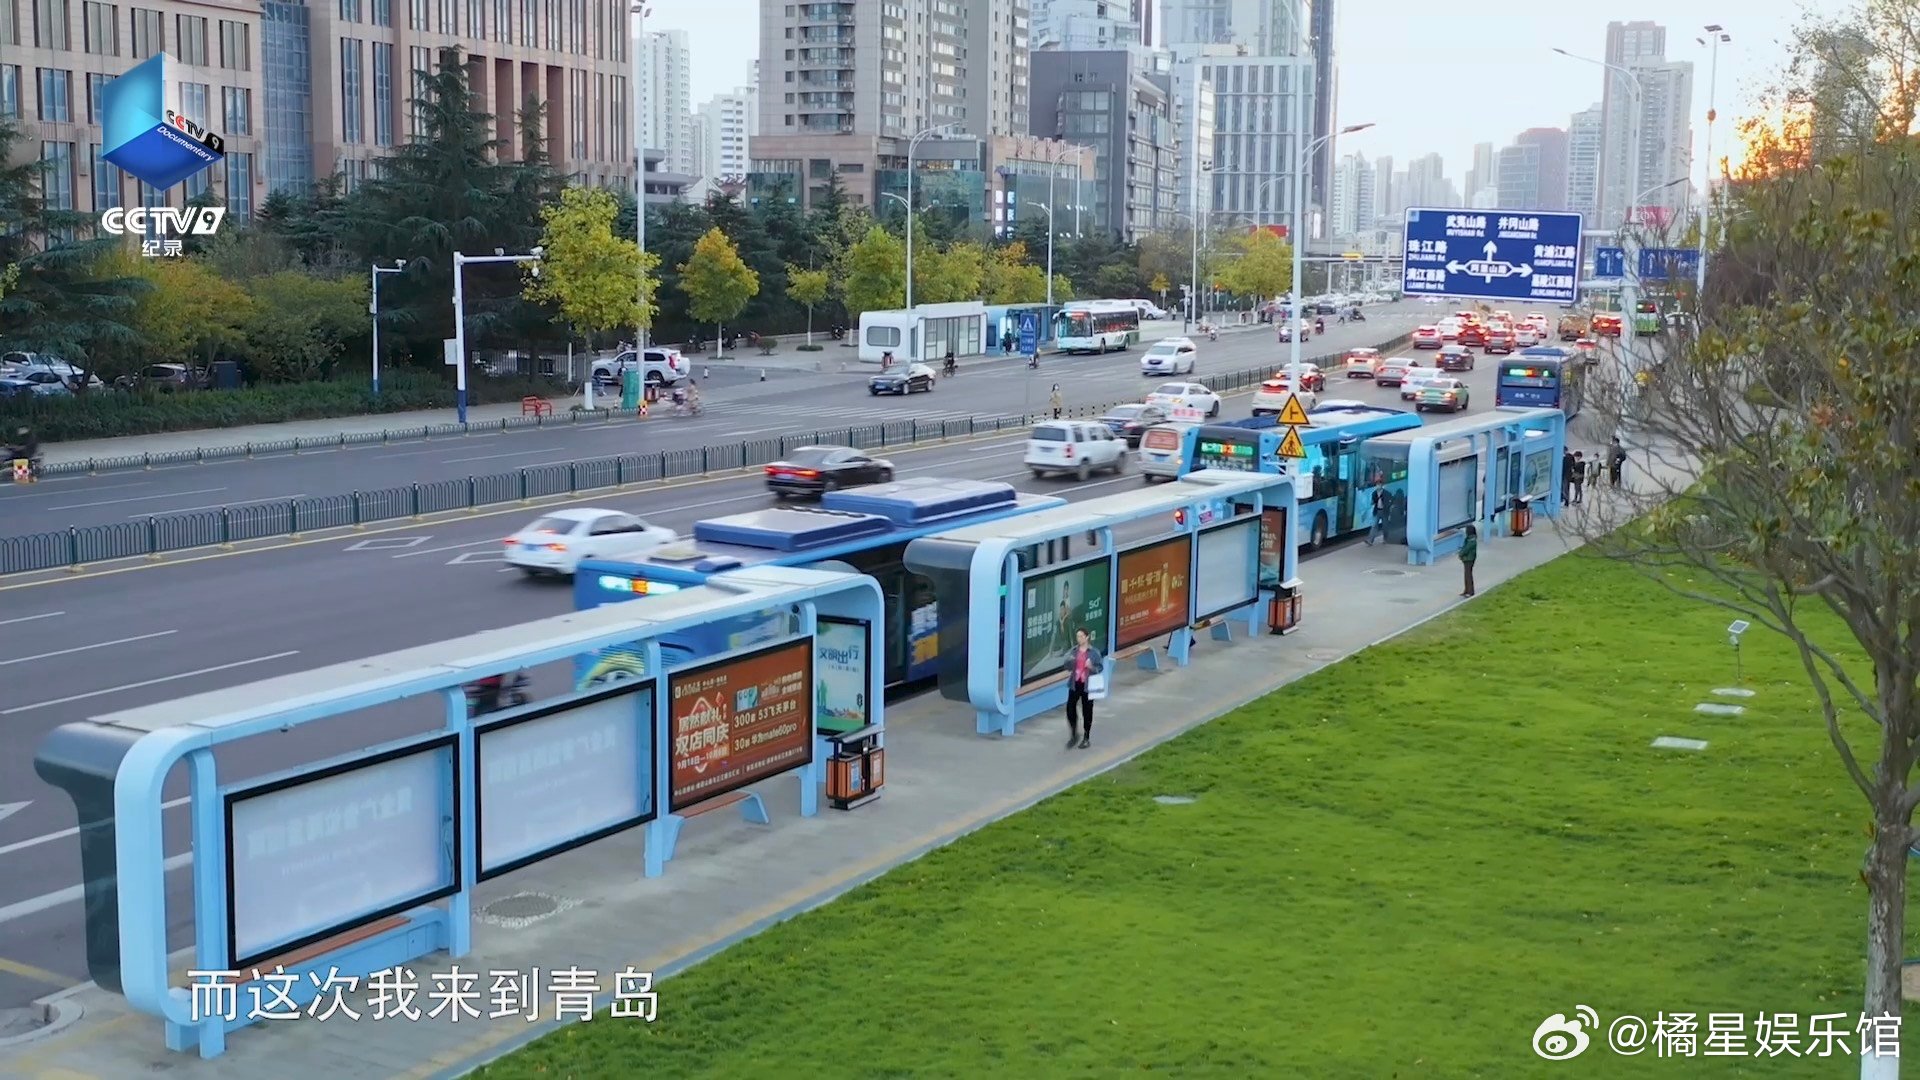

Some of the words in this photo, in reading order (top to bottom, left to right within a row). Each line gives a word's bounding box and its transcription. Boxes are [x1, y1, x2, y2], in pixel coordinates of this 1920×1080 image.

[1446, 215, 1486, 228] 武夷山路
[1498, 217, 1539, 231] 井冈山路
[1408, 240, 1448, 253] 珠江路
[1534, 245, 1575, 259] 黄浦江路
[1470, 264, 1508, 274] 阿里山路
[675, 723, 730, 756] 双店同庆
